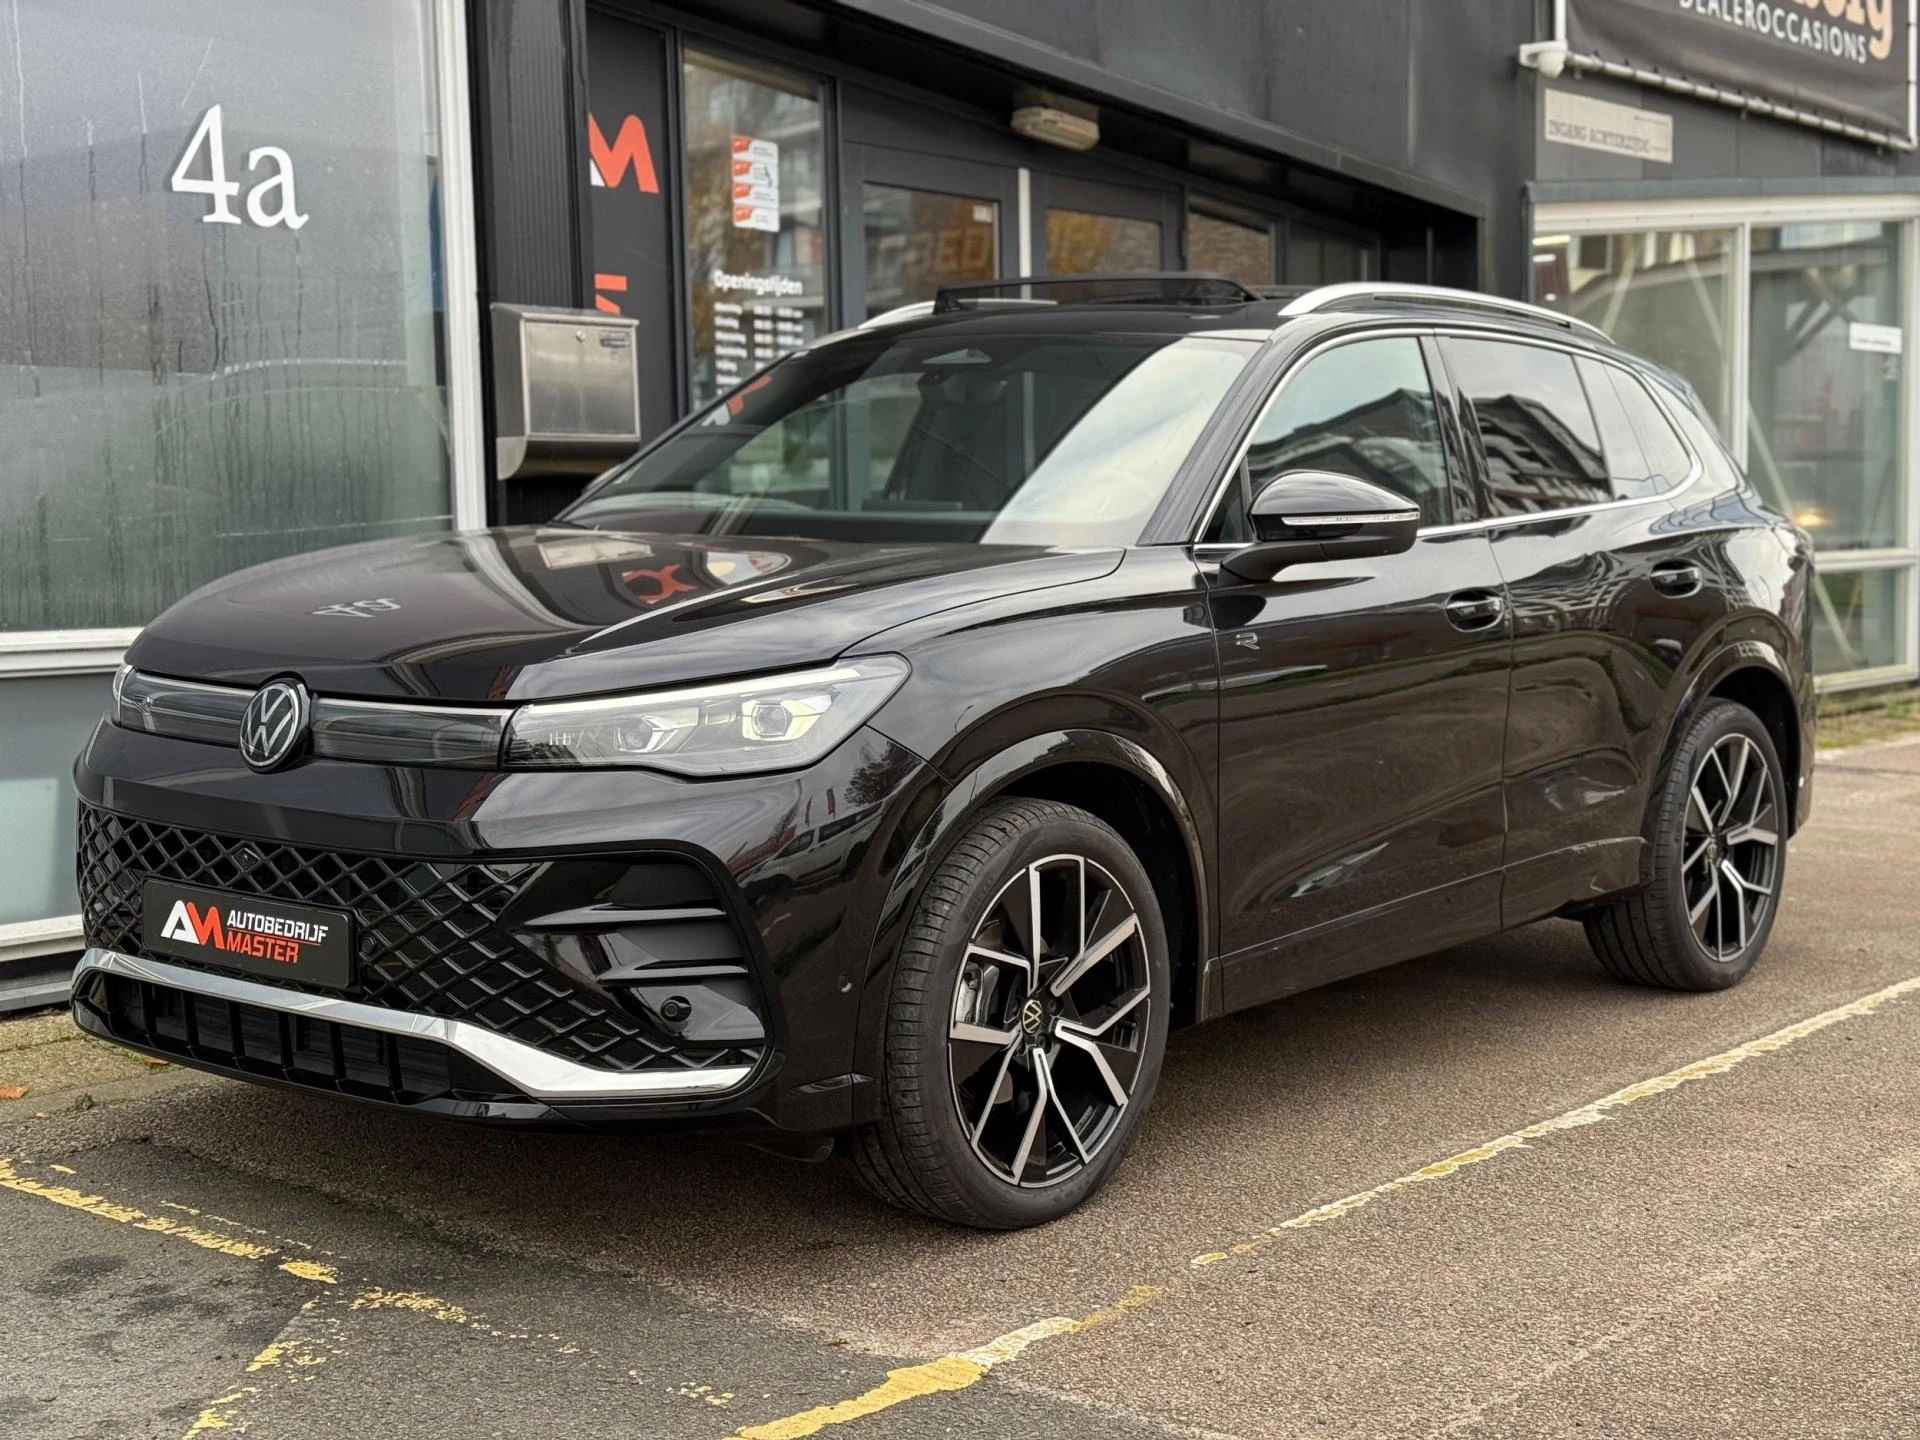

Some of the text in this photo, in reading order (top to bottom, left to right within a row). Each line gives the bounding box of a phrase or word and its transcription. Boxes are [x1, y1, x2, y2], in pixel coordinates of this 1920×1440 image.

[171, 103, 309, 220] 4a
[588, 111, 660, 194] M
[226, 909, 329, 943] AUTOBEDRIJF
[226, 931, 300, 964] MASTER
